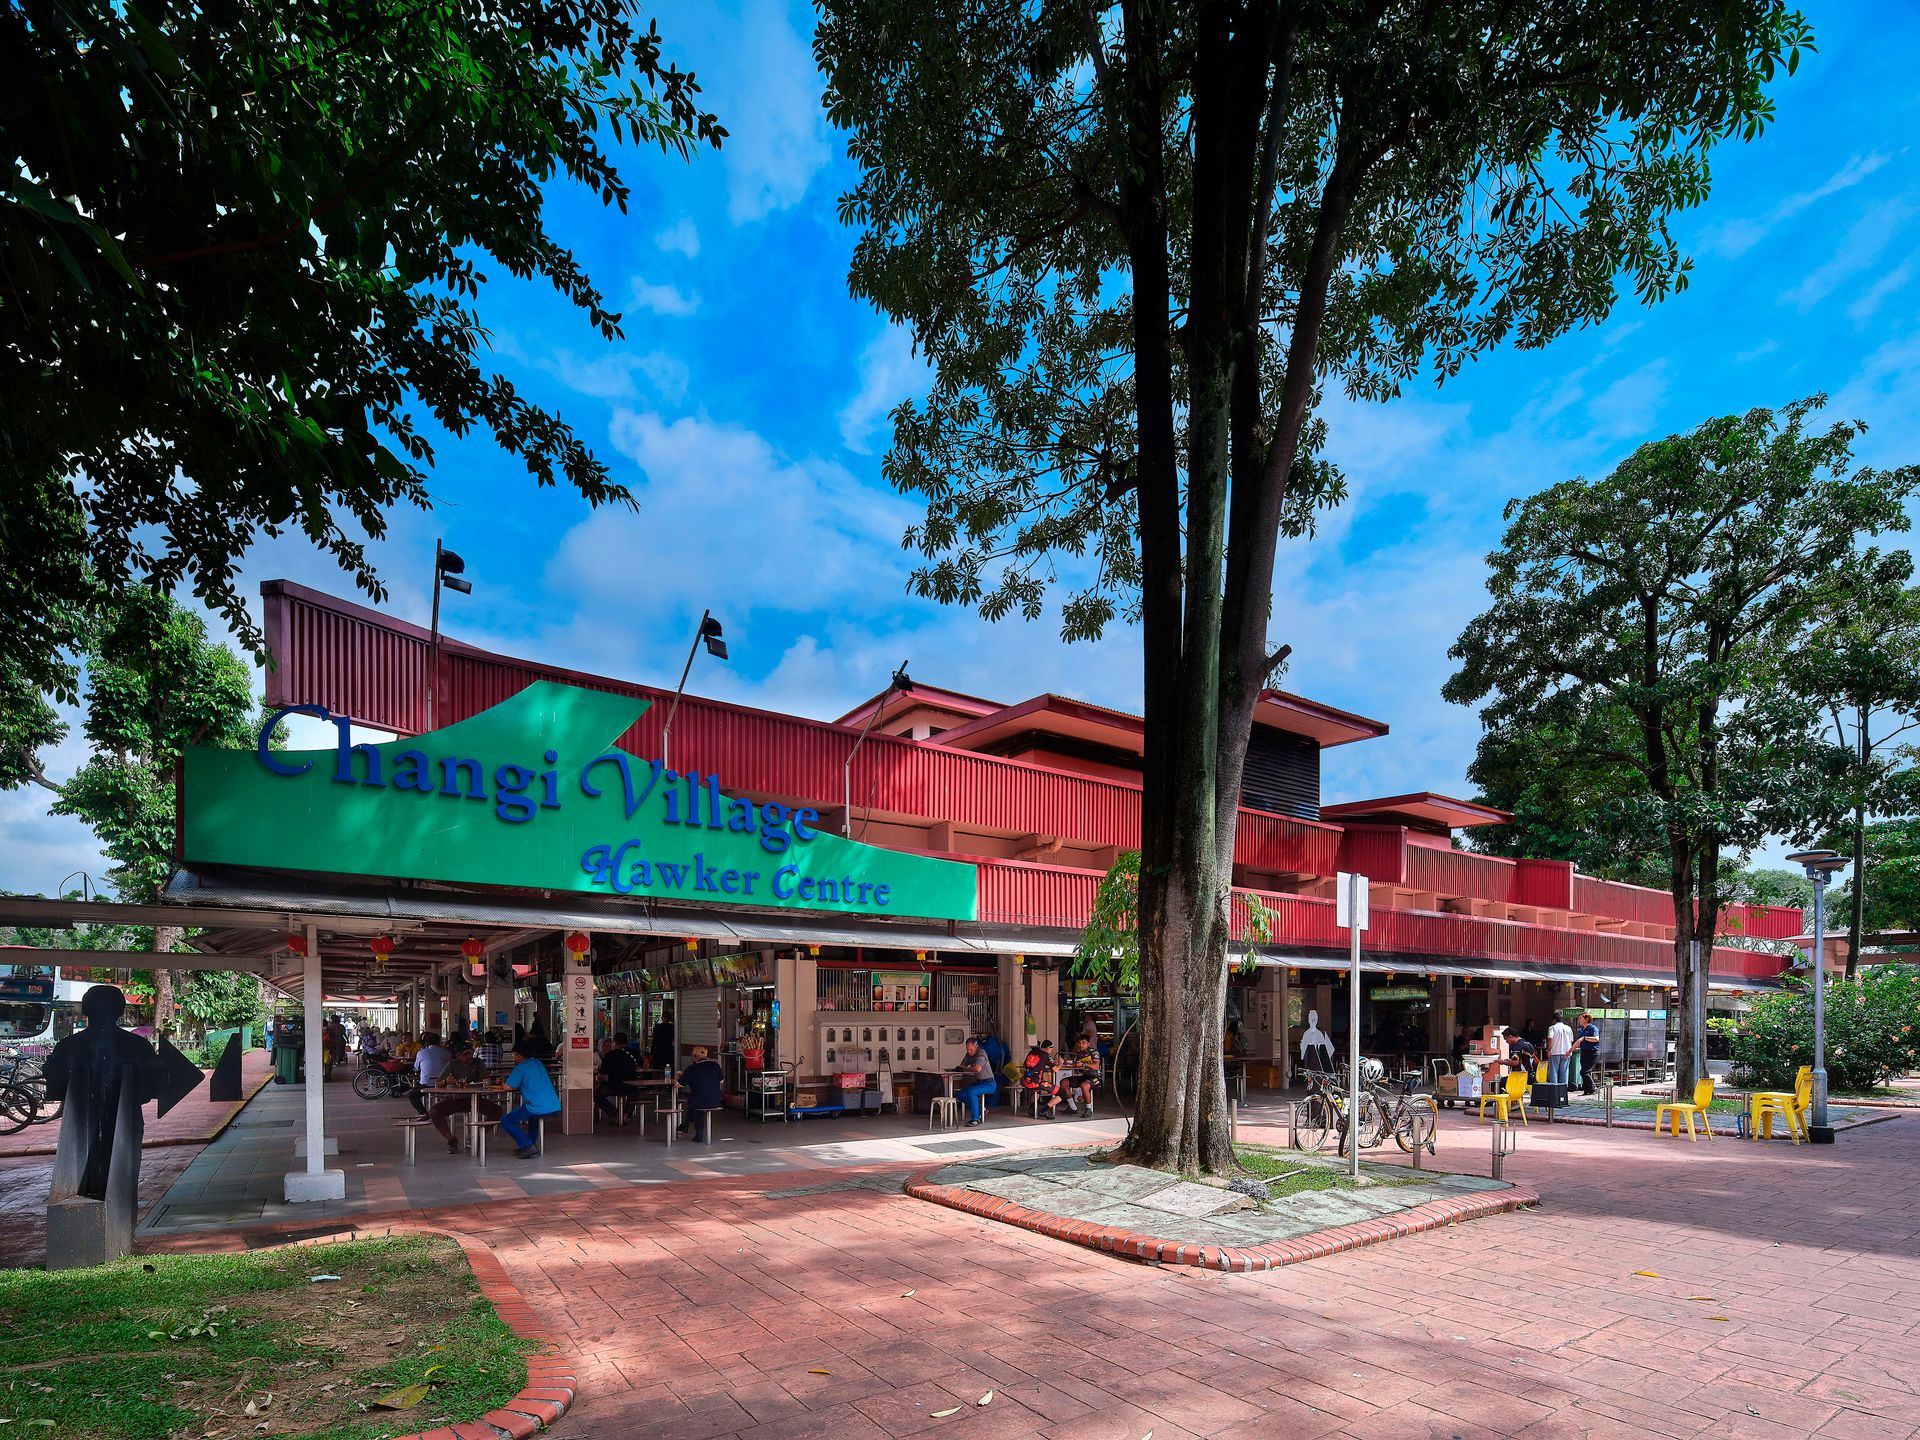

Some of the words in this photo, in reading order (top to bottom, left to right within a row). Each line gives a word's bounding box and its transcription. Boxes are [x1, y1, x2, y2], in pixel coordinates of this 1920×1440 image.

[257, 703, 562, 823] Changi
[580, 752, 820, 853] Village
[580, 838, 760, 895] Hawker
[772, 863, 892, 906] Centre
[28, 985, 43, 993] 109
